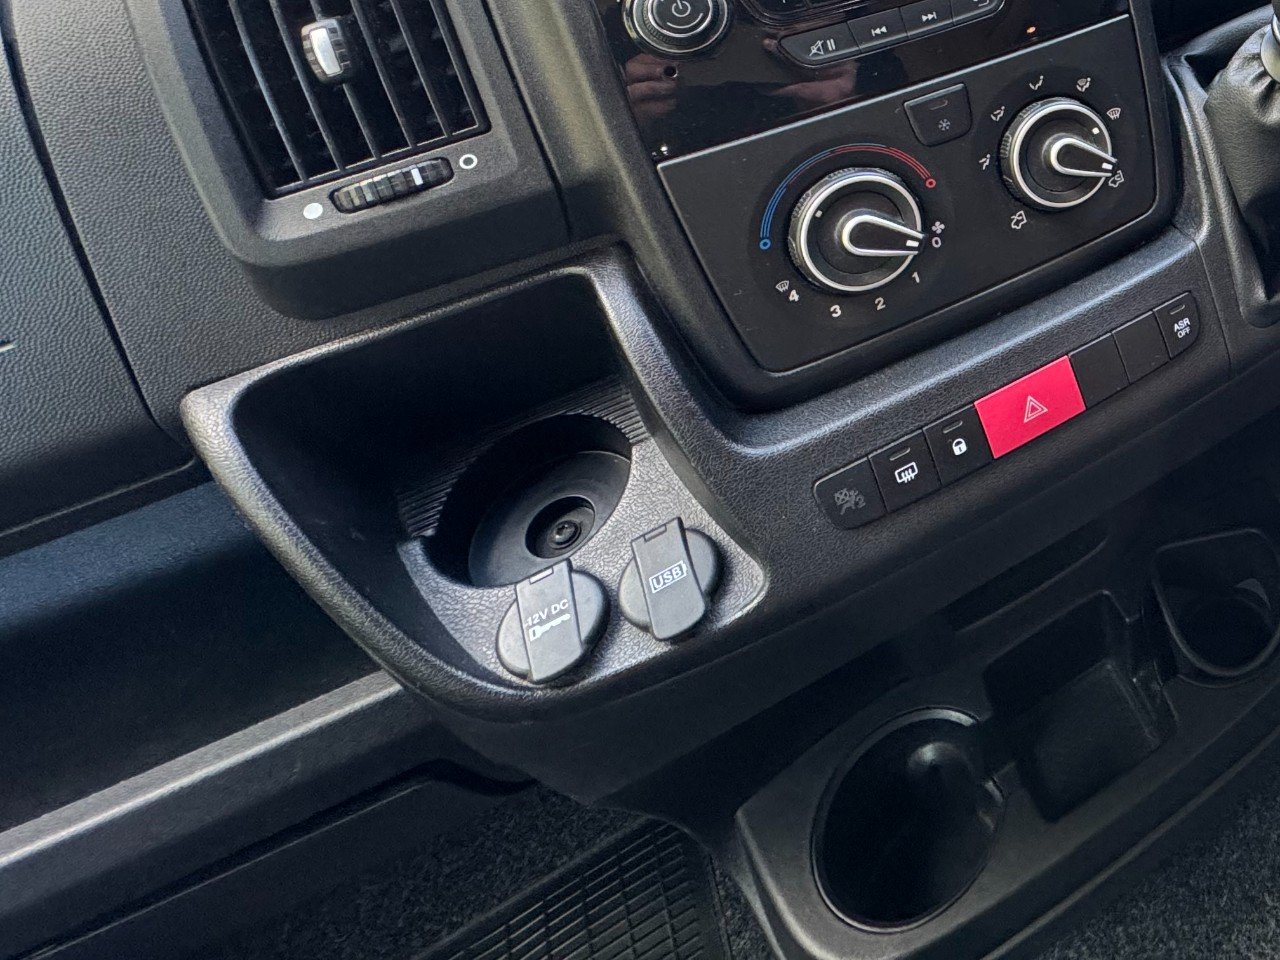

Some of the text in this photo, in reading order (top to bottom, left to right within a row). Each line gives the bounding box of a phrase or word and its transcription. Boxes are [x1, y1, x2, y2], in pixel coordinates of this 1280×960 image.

[912, 271, 920, 283] 1
[788, 289, 799, 302] 4
[875, 297, 886, 310] 2
[830, 304, 841, 317] 3
[1174, 317, 1190, 332] ASR
[1177, 326, 1190, 338] OFF
[652, 566, 681, 588] USB
[527, 599, 569, 626] 12V DC
